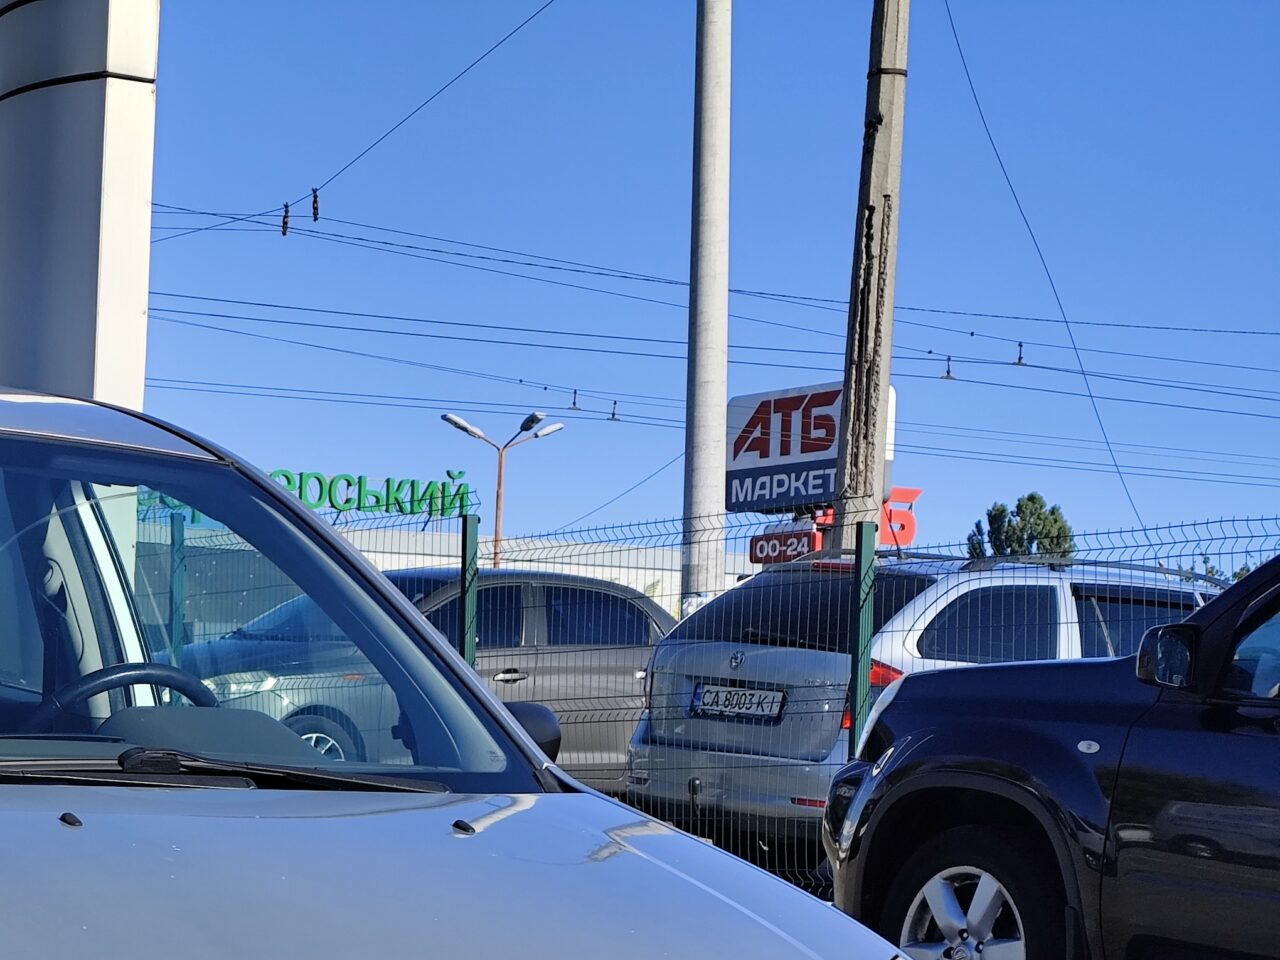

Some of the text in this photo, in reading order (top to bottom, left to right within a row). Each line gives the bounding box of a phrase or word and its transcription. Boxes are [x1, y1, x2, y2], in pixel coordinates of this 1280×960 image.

[733, 389, 843, 461] АТБ
[731, 468, 838, 503] МАРКЕТ
[756, 536, 809, 558] 00-24
[702, 689, 776, 713] CA 8003 KI
